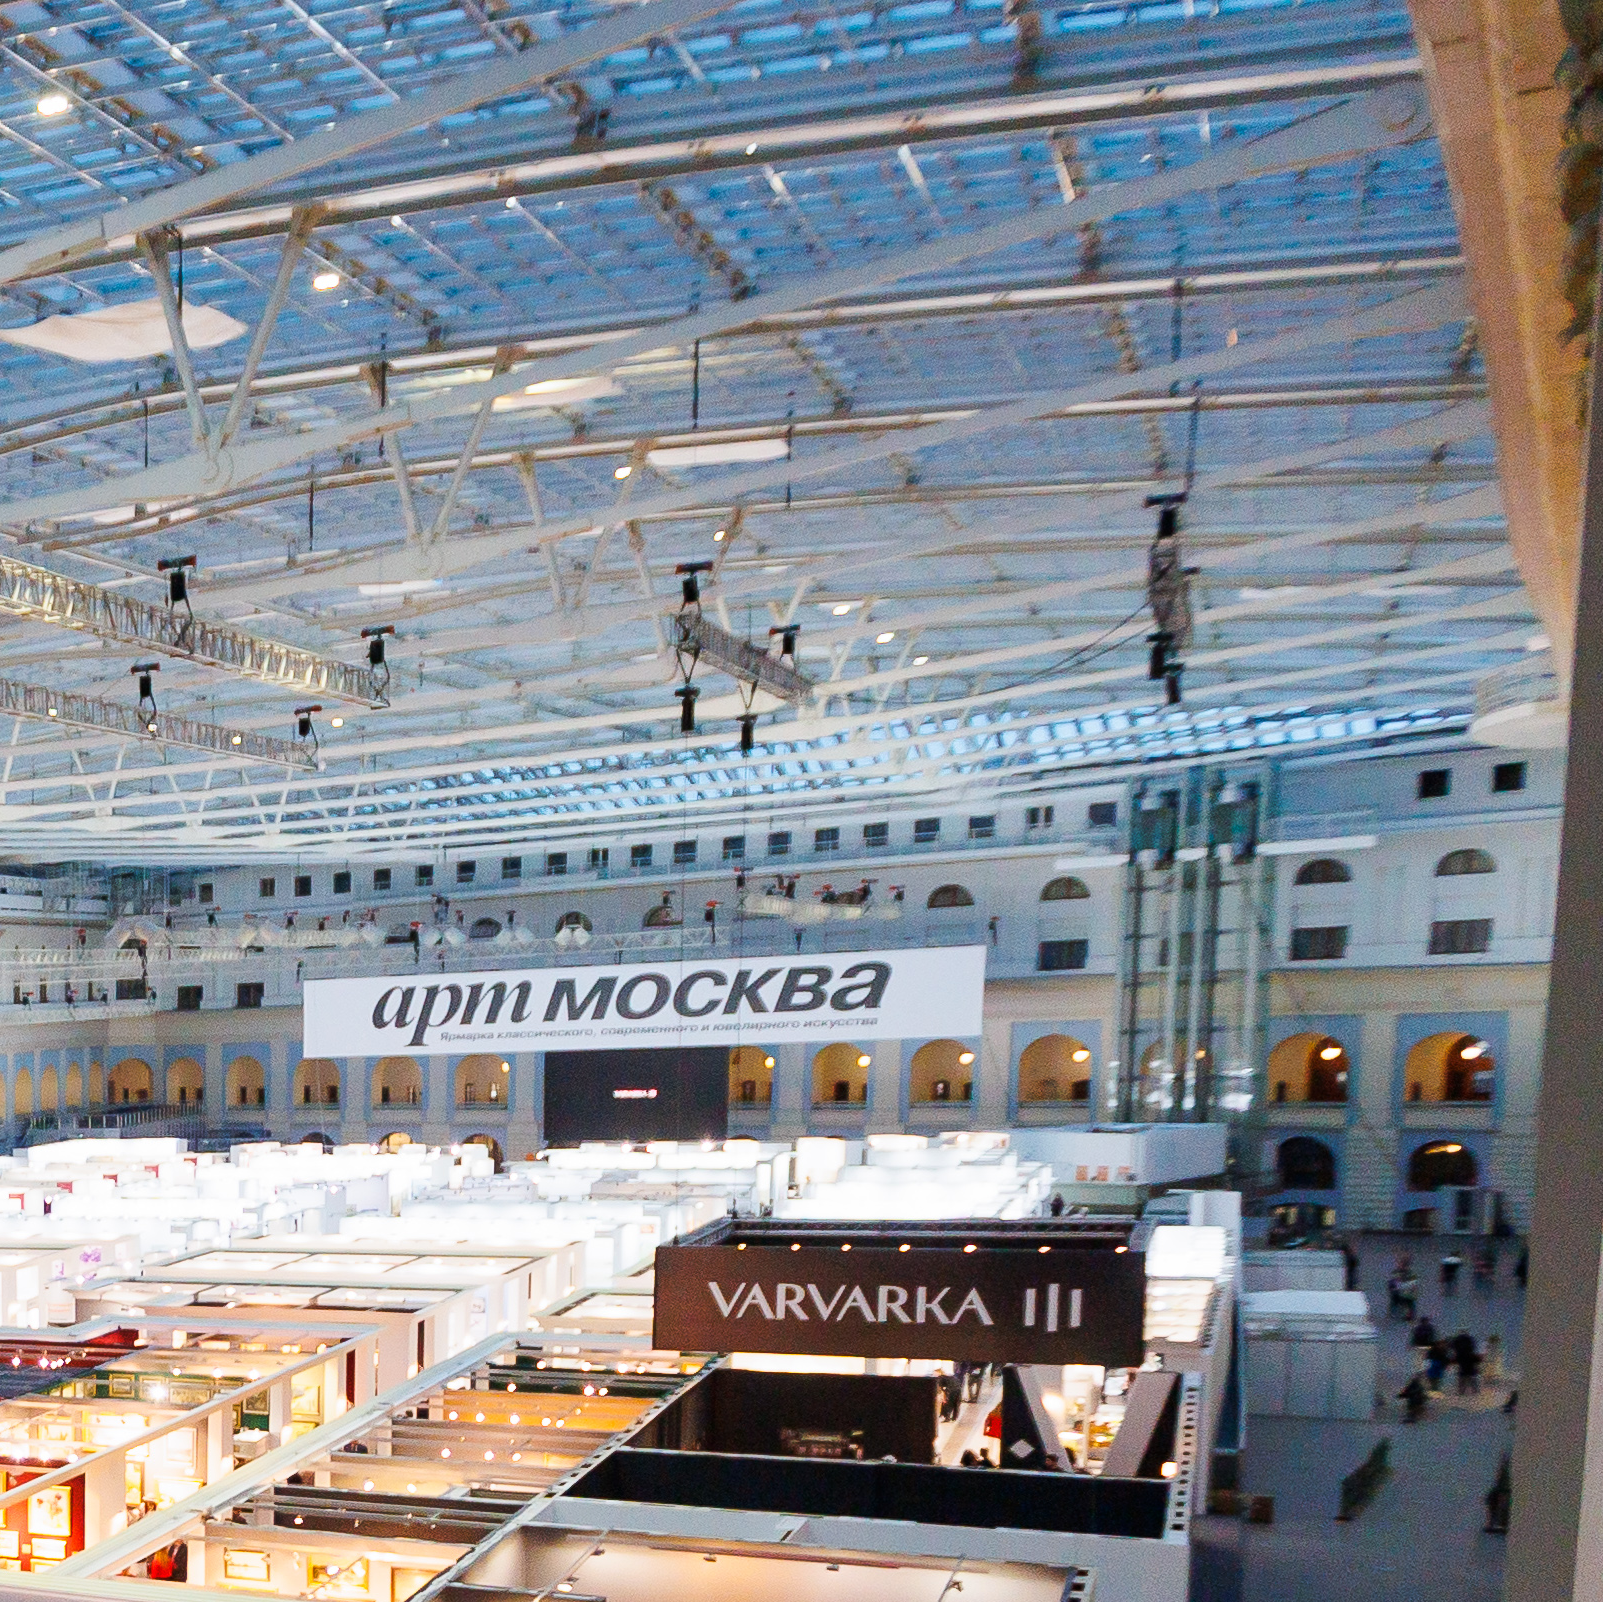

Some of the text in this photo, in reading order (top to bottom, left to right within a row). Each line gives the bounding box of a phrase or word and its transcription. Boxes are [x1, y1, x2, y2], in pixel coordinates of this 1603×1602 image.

[371, 977, 533, 1047] арт
[440, 1030, 495, 1043] Ярмарка
[600, 1022, 699, 1037] современного
[700, 1024, 710, 1032] и
[712, 1019, 801, 1033] ювелирного
[802, 1017, 879, 1030] искусства
[707, 1281, 995, 1326] VARVARKA
